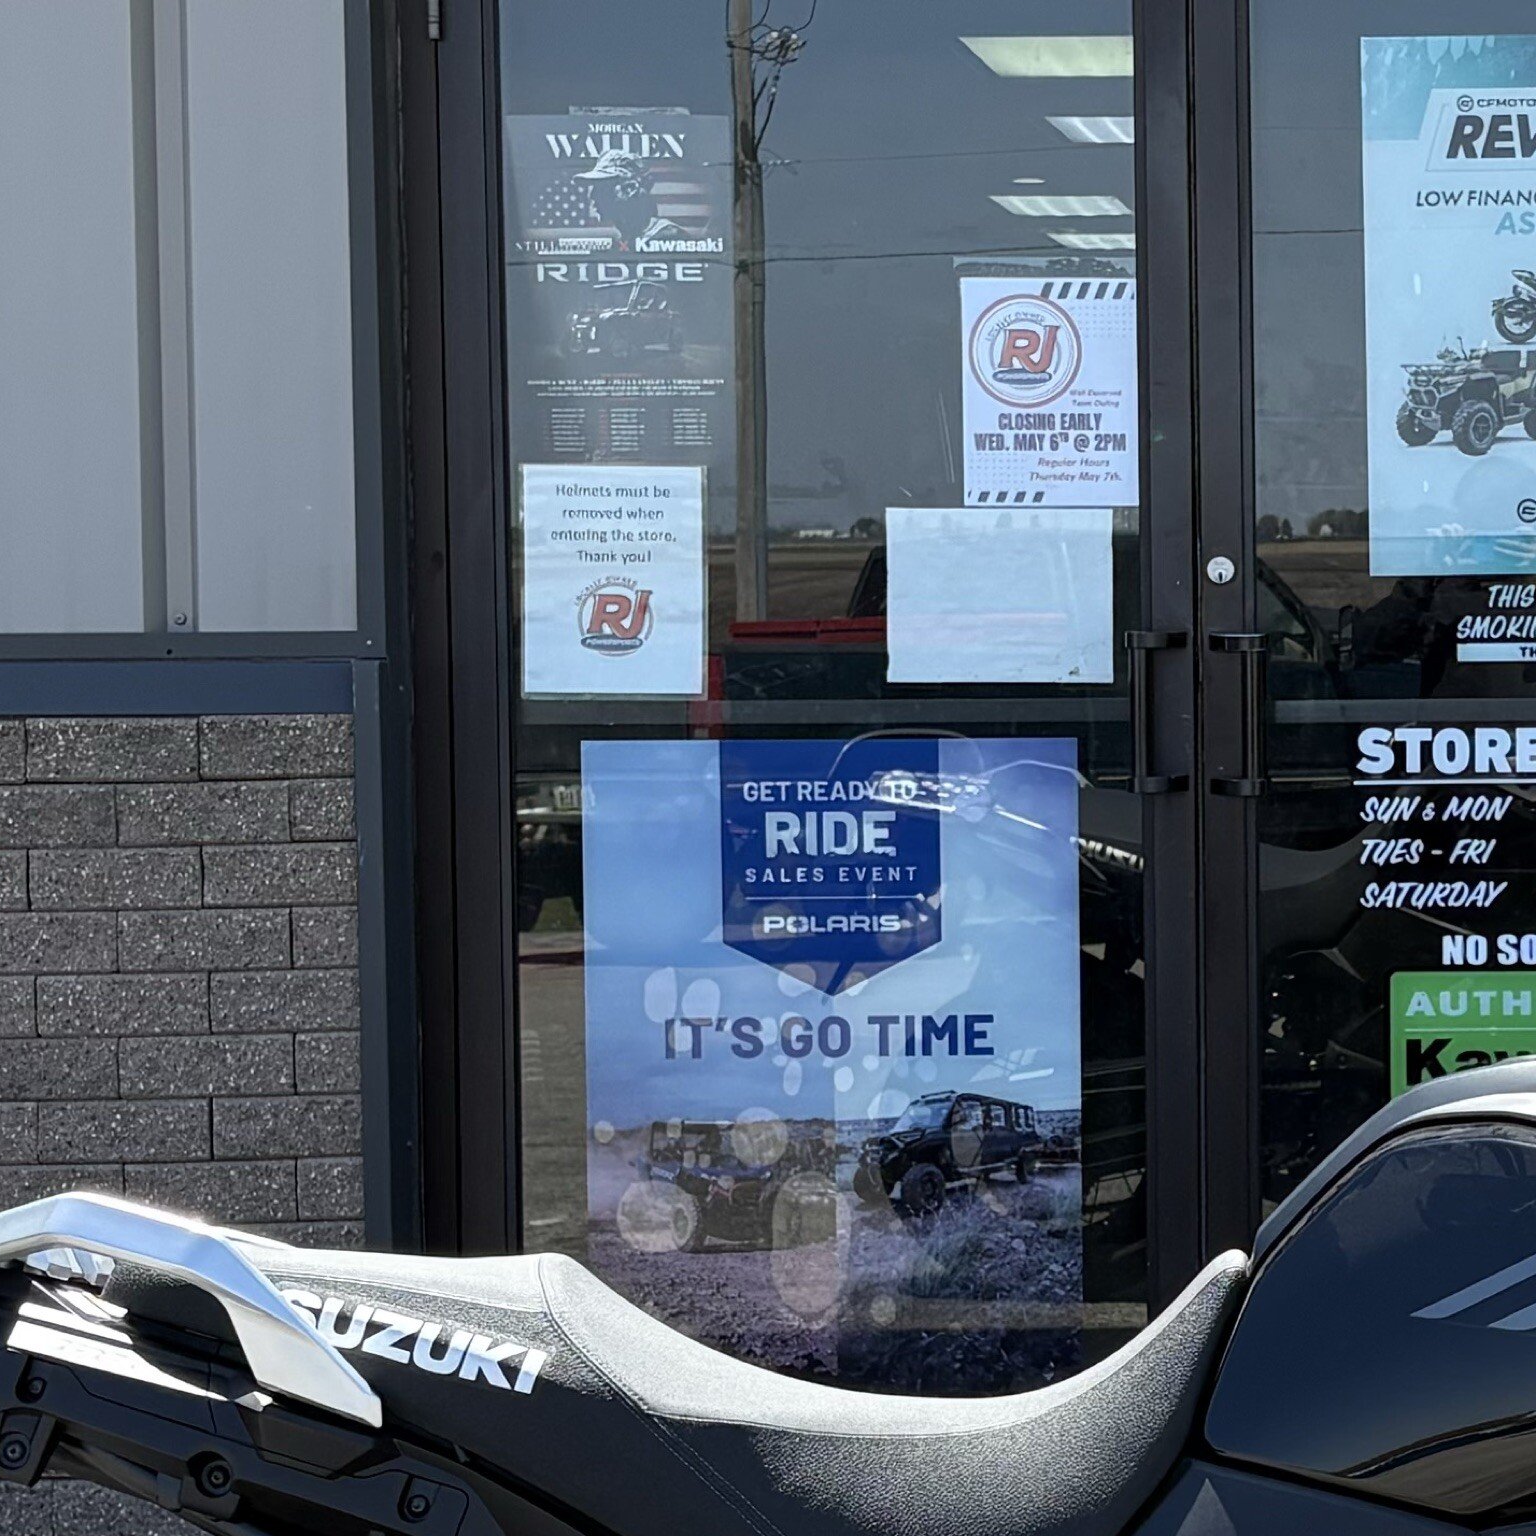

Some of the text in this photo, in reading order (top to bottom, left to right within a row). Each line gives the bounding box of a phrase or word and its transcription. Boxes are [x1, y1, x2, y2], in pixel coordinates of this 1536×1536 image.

[587, 123, 643, 133] MORGAN
[1416, 190, 1463, 207] LOW
[635, 238, 723, 253] Kawasaki
[536, 263, 704, 283] RIDGE
[998, 413, 1103, 431] CLOSING EARLY
[974, 433, 1011, 451] WED.
[1014, 433, 1046, 451] MAY
[1073, 433, 1091, 453] @
[1094, 433, 1127, 451] 2PM
[556, 484, 670, 499] Helmets must be
[562, 507, 665, 520] removed when
[550, 530, 608, 543] entering
[611, 529, 634, 542] the
[576, 550, 618, 563] Thank
[1488, 584, 1536, 608] THIS
[586, 589, 653, 639] RJ
[743, 781, 792, 803] GET
[797, 781, 877, 802] READY
[1360, 795, 1421, 824] SUN
[1422, 802, 1436, 822] &
[1441, 795, 1514, 822] MON
[765, 810, 897, 858] RIDE
[1360, 838, 1425, 866] TUES
[1449, 838, 1497, 864] FRI
[745, 866, 918, 883] SALES EVENT
[1360, 881, 1509, 909] SATURDAY
[763, 915, 901, 934] POLARIS
[1442, 935, 1488, 965] NO
[664, 1014, 995, 1059] IT'S GO TIME
[279, 1288, 548, 1395] SUZUKI
